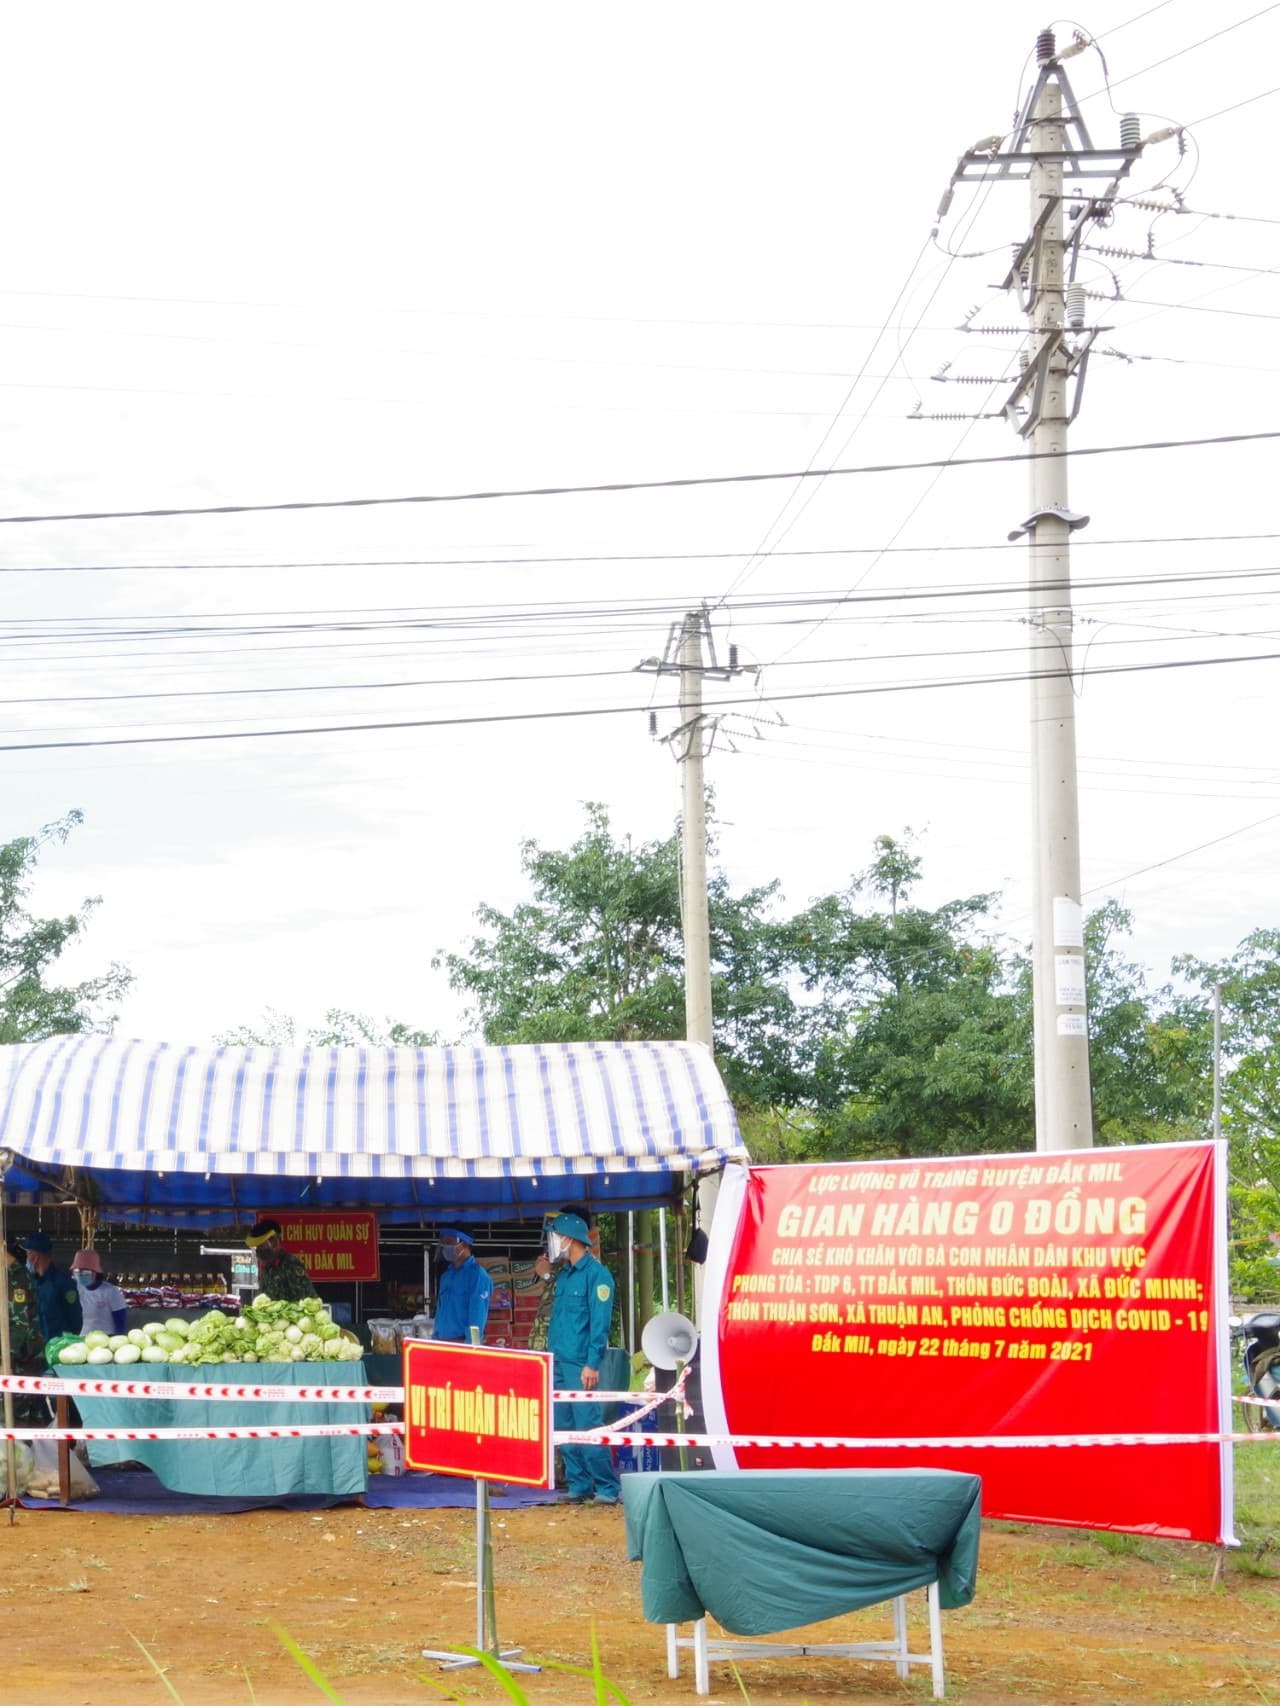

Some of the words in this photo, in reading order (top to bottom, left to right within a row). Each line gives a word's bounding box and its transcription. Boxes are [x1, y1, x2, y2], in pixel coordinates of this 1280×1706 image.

[808, 1175, 841, 1194] LỰC
[840, 1172, 896, 1194] LƯỢNG
[899, 1169, 921, 1189] VŨ
[923, 1168, 978, 1188] TRANG
[981, 1165, 1045, 1189] HUYỆN
[1045, 1159, 1086, 1184] ĐẮK
[1088, 1162, 1124, 1182] MIL
[776, 1203, 866, 1238] GIAN
[870, 1196, 981, 1236] HÀNG
[1023, 1186, 1148, 1235] ĐỒNG
[305, 1224, 324, 1241] HUY
[337, 1253, 356, 1270] MIL
[772, 1247, 804, 1266] CHIA
[805, 1242, 824, 1266] SẺ
[825, 1244, 854, 1266] KHÓ
[855, 1244, 896, 1266] KHĂN
[898, 1243, 922, 1266] VỚI
[925, 1243, 946, 1267] BÀ
[948, 1246, 982, 1267] CON
[984, 1243, 1030, 1267] NHÂN
[1033, 1242, 1068, 1268] DÂN
[1071, 1247, 1108, 1268] KHU
[1110, 1246, 1147, 1272] VỰC
[732, 1273, 777, 1294] PHONG
[813, 1274, 841, 1295] TDP
[842, 1275, 857, 1297] 6,
[859, 1275, 877, 1296] TT
[910, 1275, 944, 1299] MIL,
[946, 1272, 989, 1298] THÔN
[991, 1272, 1025, 1298] ĐỨC
[1027, 1272, 1074, 1300] ĐOÀI,
[1076, 1273, 1102, 1299] XÃ
[1104, 1273, 1142, 1299] ĐỨC
[1144, 1277, 1204, 1302] MINH;
[726, 1298, 761, 1322] THÔN
[762, 1299, 807, 1326] THUẬN
[808, 1302, 844, 1326] SƠN,
[846, 1301, 867, 1324] XÃ
[868, 1301, 919, 1329] THUẬN
[921, 1305, 949, 1328] AN,
[950, 1301, 1007, 1328] PHÒNG
[1008, 1300, 1068, 1330] CHỐNG
[1070, 1307, 1113, 1334] DỊCH
[1115, 1308, 1172, 1331] COVID
[1187, 1310, 1209, 1333] 19
[812, 1331, 841, 1353] Đắk
[843, 1335, 875, 1356] Mil,
[877, 1336, 917, 1358] ngày
[918, 1337, 941, 1357] 22
[942, 1338, 991, 1361] tháng
[994, 1339, 1006, 1359] 7
[1007, 1339, 1048, 1360] năm
[1049, 1340, 1094, 1362] 2021
[410, 1384, 426, 1437] VỊ
[427, 1380, 452, 1431] TRÍ
[453, 1384, 496, 1445] NHẬN
[497, 1387, 540, 1442] HÀNG
